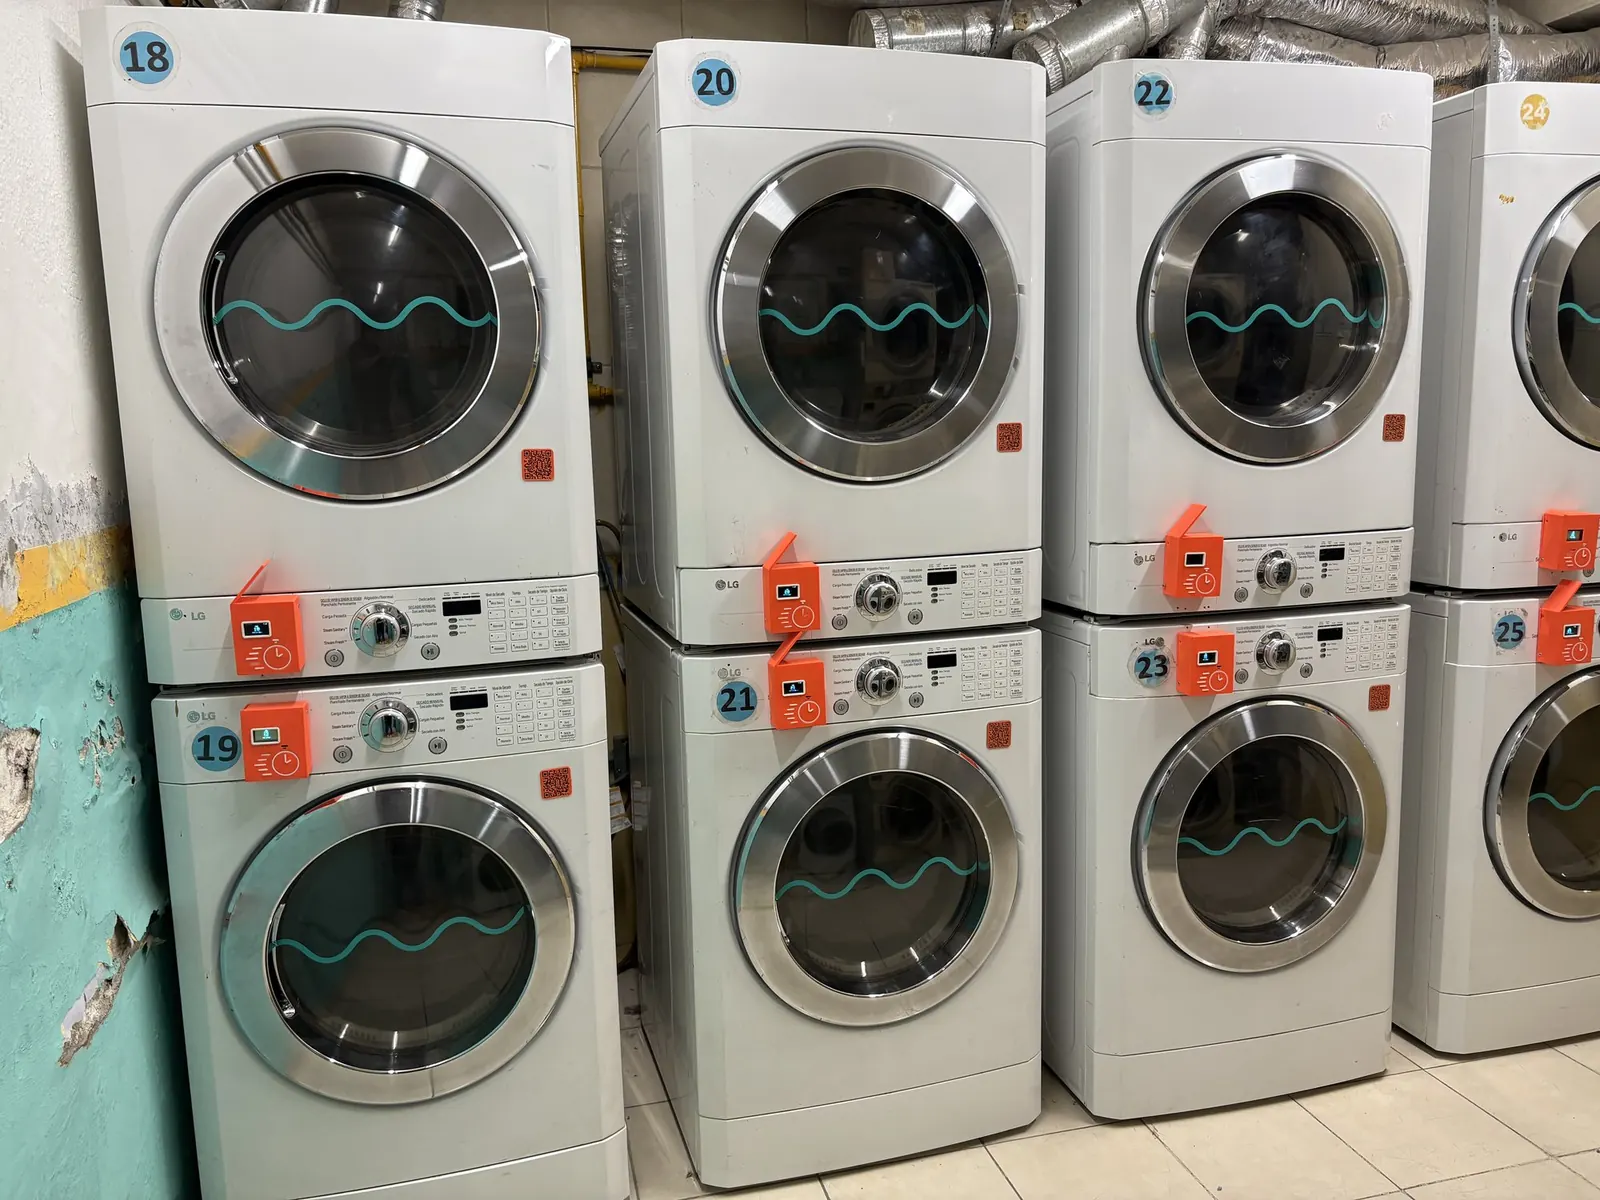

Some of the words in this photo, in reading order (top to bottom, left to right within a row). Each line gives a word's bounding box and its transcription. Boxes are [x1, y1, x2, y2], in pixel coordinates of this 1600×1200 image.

[124, 41, 169, 72] 18
[697, 68, 734, 95] 20
[1138, 80, 1170, 106] 22
[1522, 103, 1546, 120] 24
[727, 581, 739, 589] LG
[191, 612, 206, 621] LG
[1497, 622, 1524, 642] 25
[1138, 654, 1168, 679] 23
[721, 687, 755, 712] 21
[201, 711, 216, 721] LG
[197, 734, 238, 762] 19
